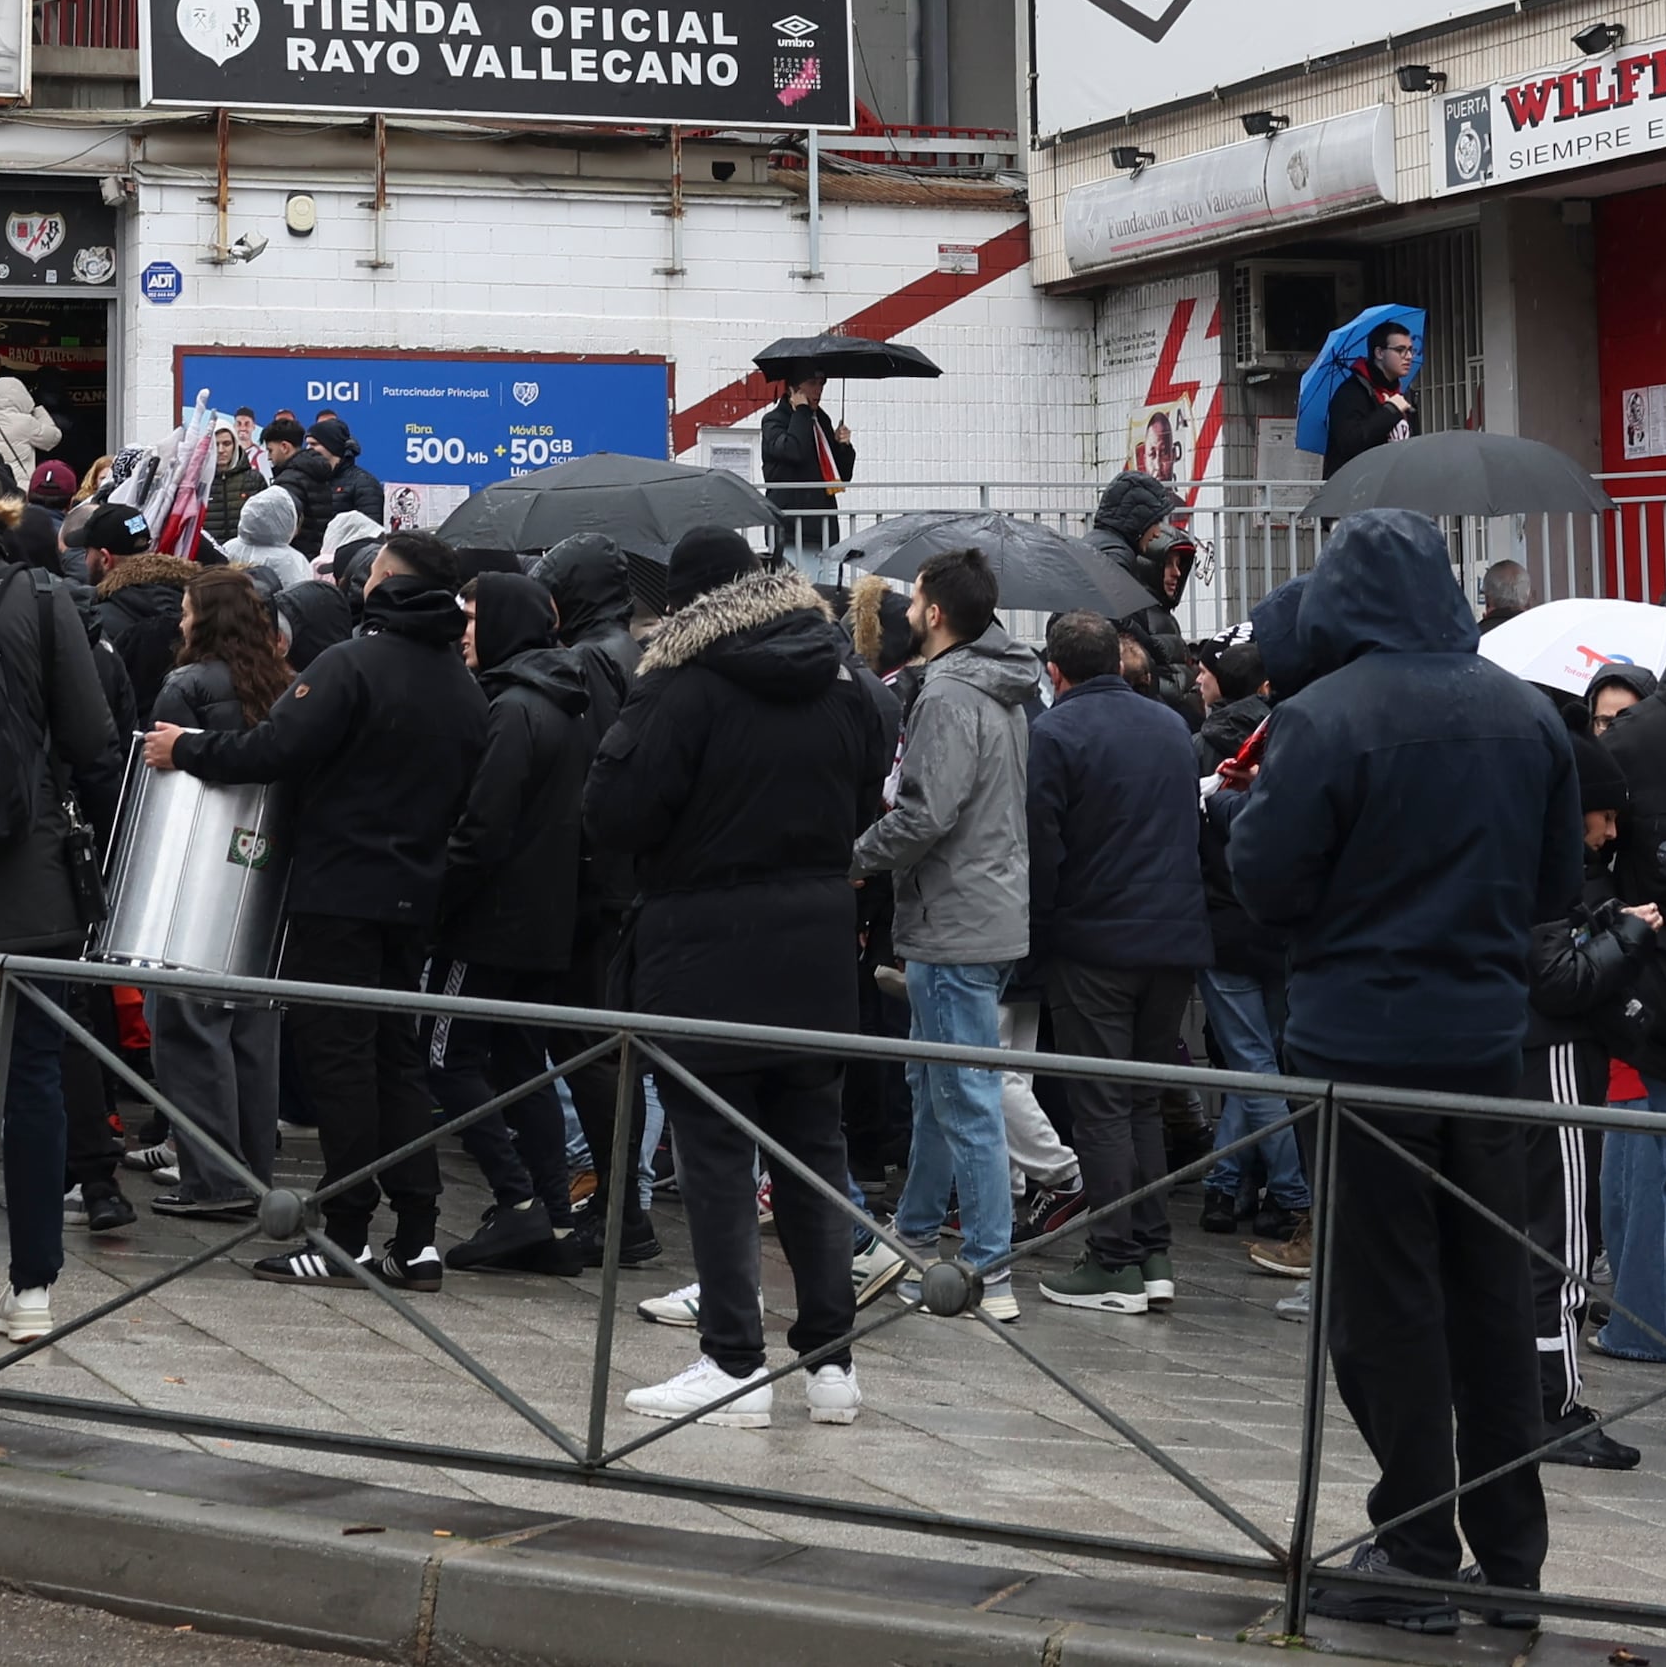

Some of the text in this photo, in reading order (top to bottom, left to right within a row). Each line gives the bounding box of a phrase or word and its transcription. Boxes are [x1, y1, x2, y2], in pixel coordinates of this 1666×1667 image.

[531, 5, 739, 45] OFICIAL
[777, 38, 815, 47] umbro
[286, 36, 740, 88] RAYO VALLECANO
[1446, 96, 1489, 121] PUERTA
[1509, 126, 1631, 170] SIEMPRE
[1172, 200, 1203, 226] Rayo
[148, 274, 176, 288] ADT
[8, 347, 34, 363] RAYO
[307, 381, 490, 402] DIGI Patrocinador Principal
[405, 423, 554, 436] Fibra Móvil 5G
[406, 438, 465, 464] 500
[466, 452, 489, 464] Mb
[510, 438, 549, 465] 50
[549, 439, 573, 453] GB
